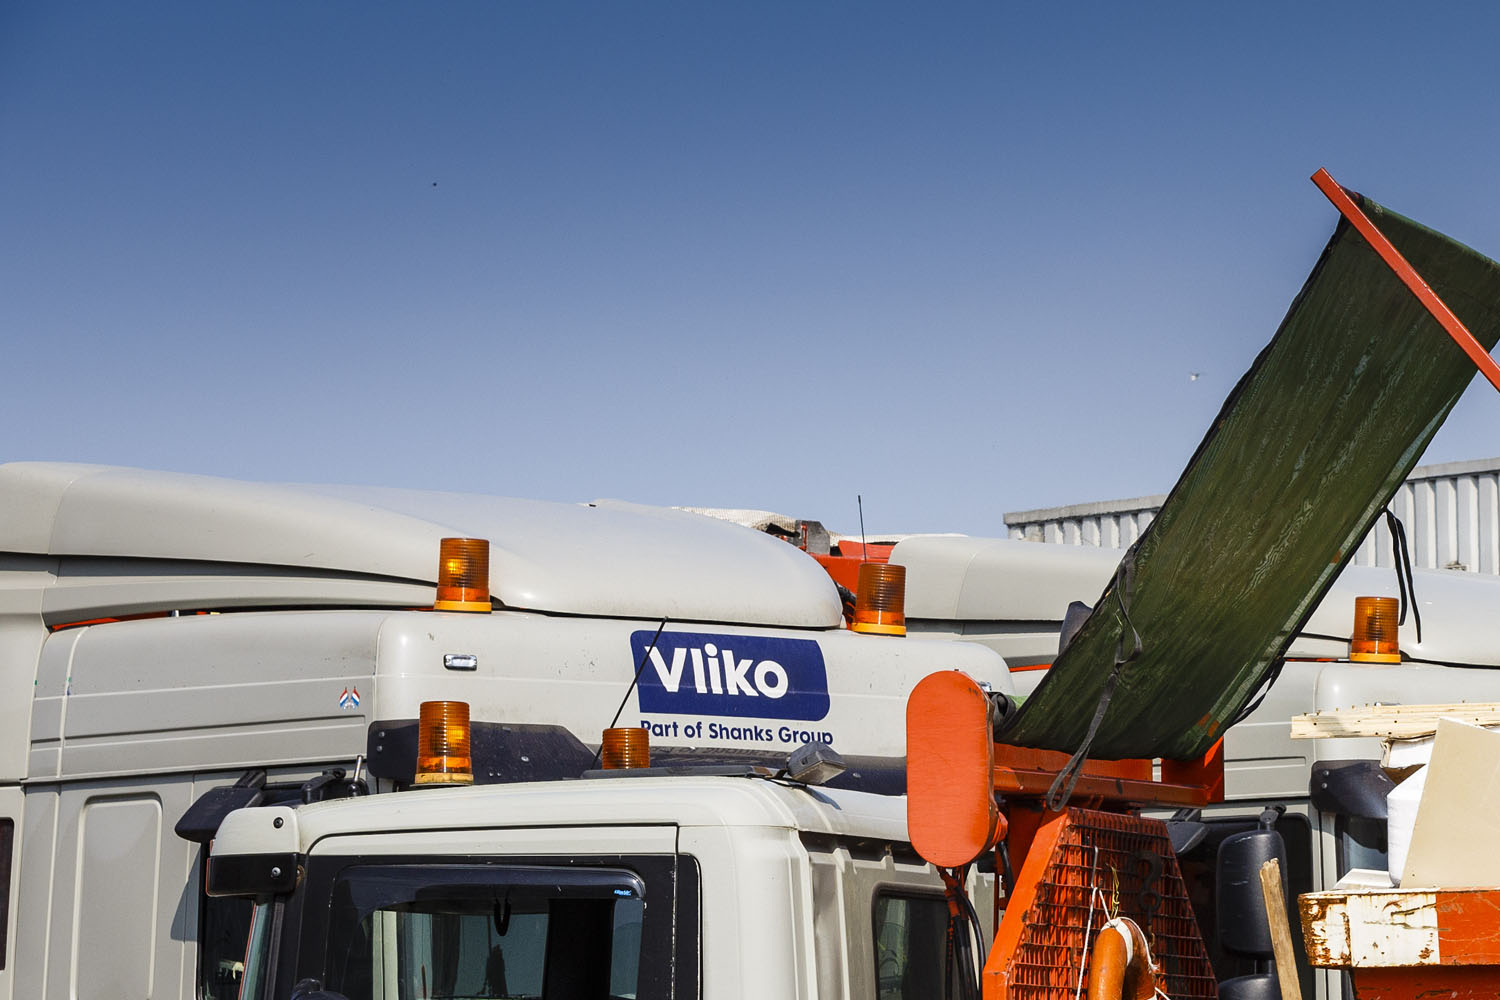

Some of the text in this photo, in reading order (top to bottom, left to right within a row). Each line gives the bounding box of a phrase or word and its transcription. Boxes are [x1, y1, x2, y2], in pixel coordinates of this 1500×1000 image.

[644, 643, 788, 699] Vliko
[641, 720, 834, 745] Part of Shanks Group
